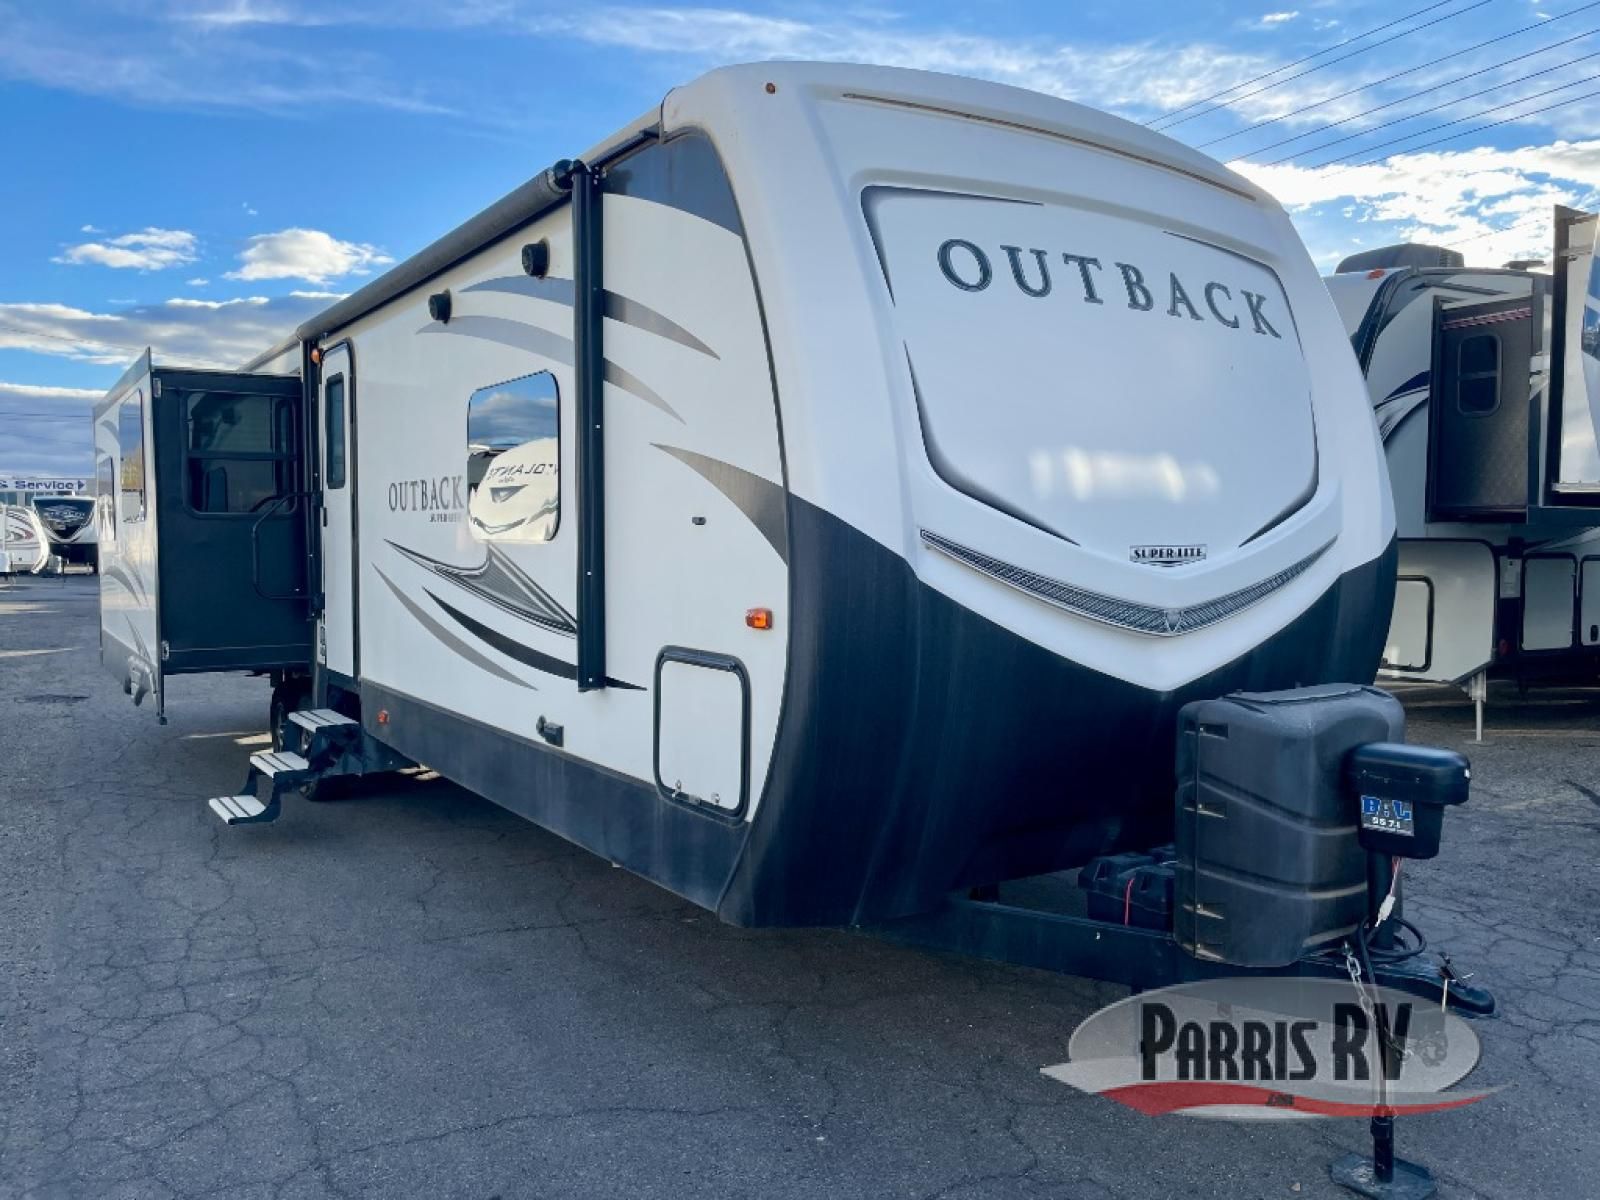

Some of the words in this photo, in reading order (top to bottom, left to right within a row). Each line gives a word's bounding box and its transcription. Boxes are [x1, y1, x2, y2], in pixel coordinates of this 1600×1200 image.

[936, 238, 1282, 340] OUTBACK
[15, 480, 74, 490] Service
[388, 475, 465, 512] OUTBACK
